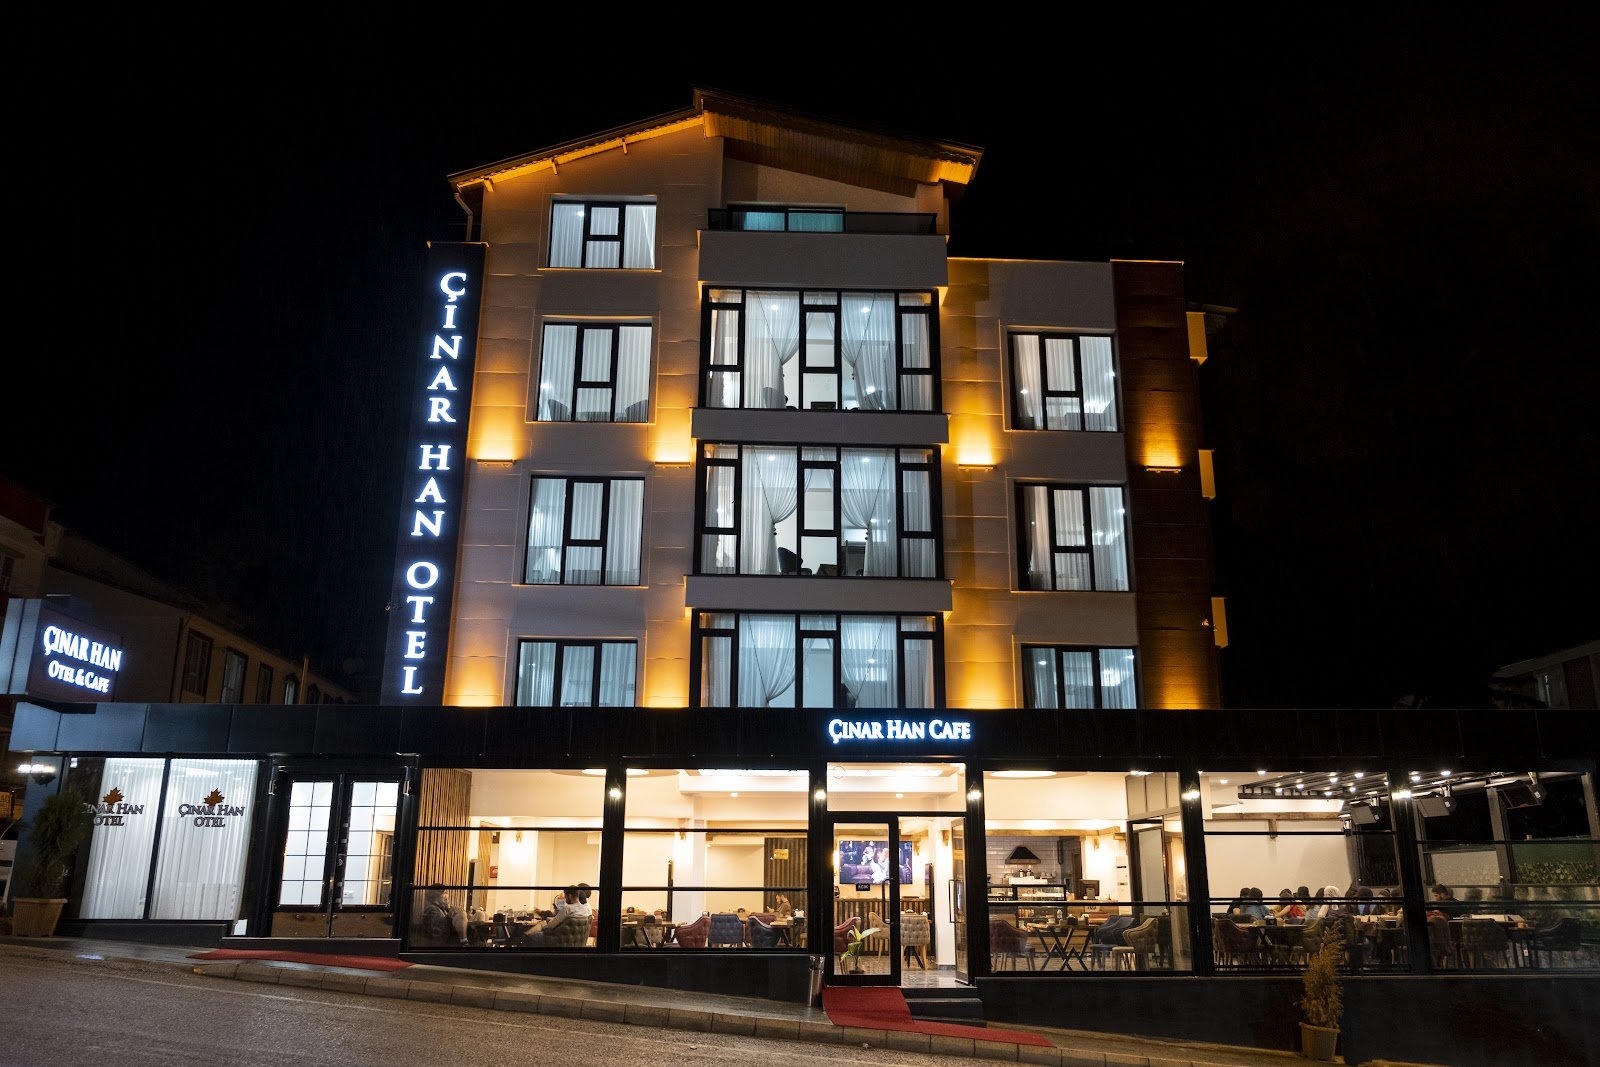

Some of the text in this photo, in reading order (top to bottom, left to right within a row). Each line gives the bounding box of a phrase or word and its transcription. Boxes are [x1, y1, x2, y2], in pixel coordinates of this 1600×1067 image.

[401, 271, 467, 695] ÇINAR HAN OTEL
[43, 625, 122, 672] ÇINAR HAN
[48, 660, 110, 693] OTEL & CAFE
[828, 718, 972, 744] ÇINAR HAN CAFE
[116, 803, 145, 815] HAN
[216, 804, 245, 816] HAN
[93, 815, 125, 826] OTEL
[194, 816, 226, 828] OTEL
